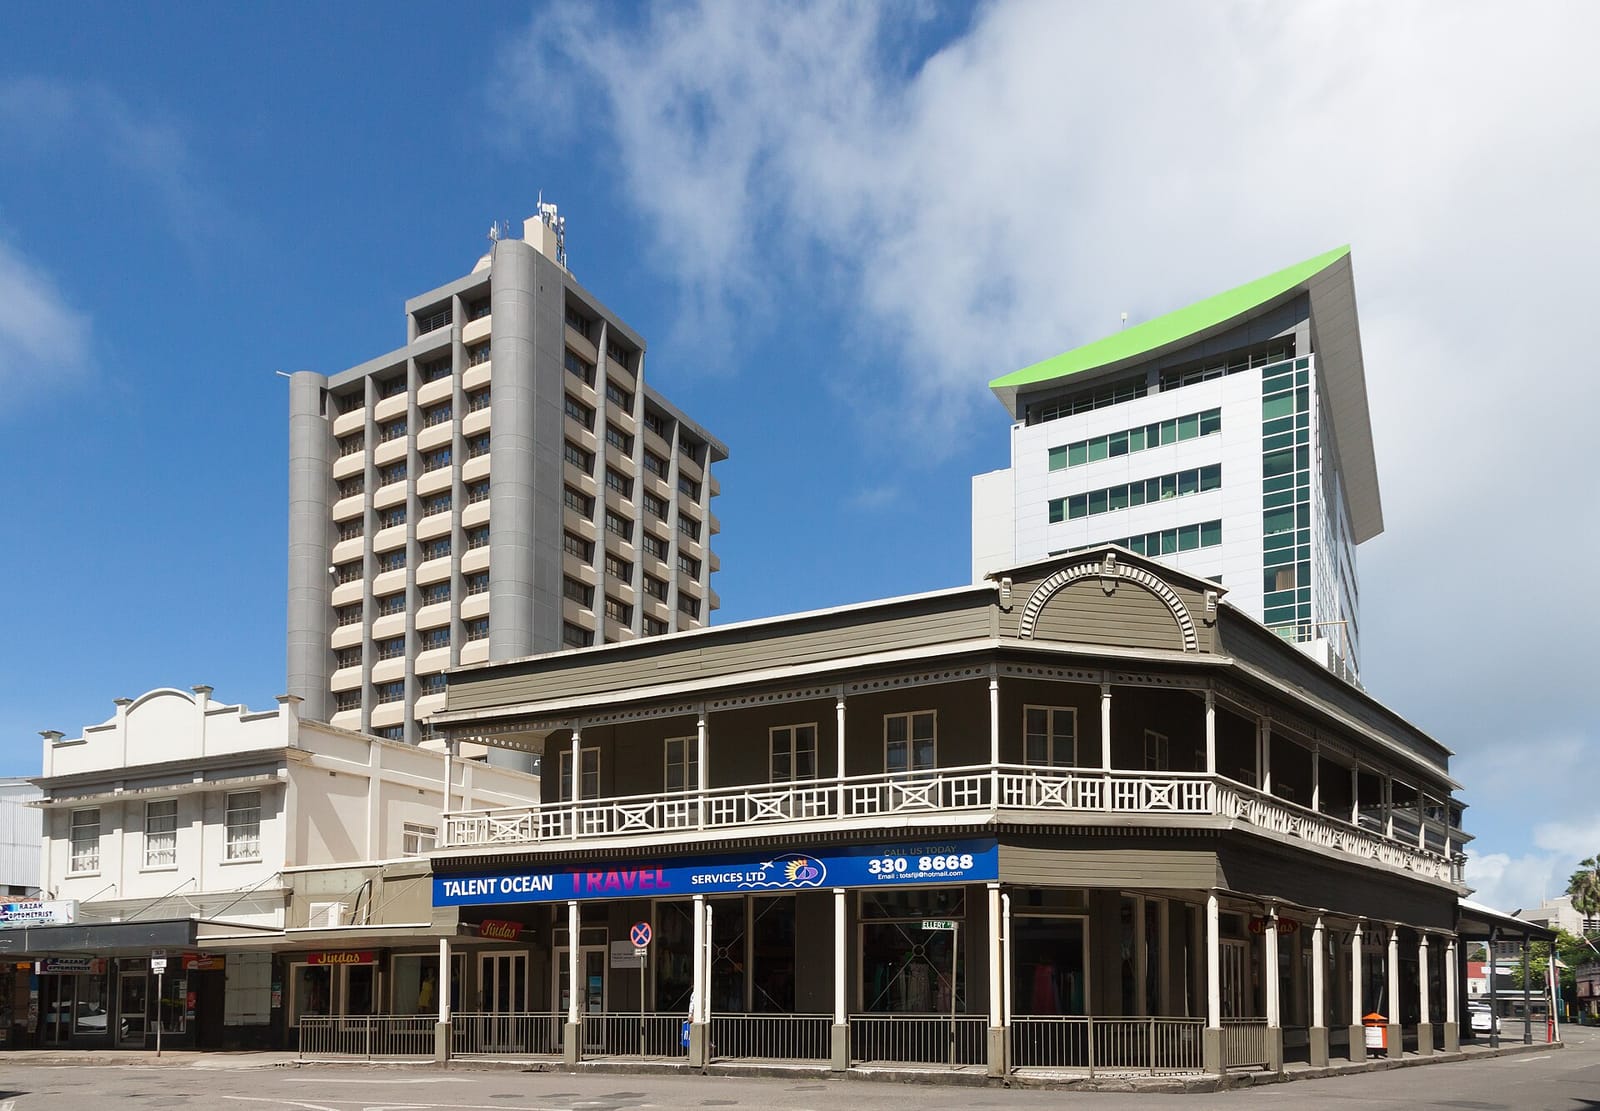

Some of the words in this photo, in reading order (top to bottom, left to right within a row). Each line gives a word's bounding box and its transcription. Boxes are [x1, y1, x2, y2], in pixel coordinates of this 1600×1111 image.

[884, 848, 907, 857] CALL
[910, 847, 922, 855] US
[926, 845, 957, 855] TODAY
[868, 857, 908, 874] 330
[918, 854, 974, 871] 8668
[443, 878, 497, 897] TALENT
[500, 875, 553, 894] OCEAN
[565, 865, 671, 893] TRAVEL
[691, 872, 743, 885] SERVICES
[746, 871, 766, 882] LTD
[9, 911, 53, 919] OPTOMETRIST
[481, 921, 516, 938] Jindas
